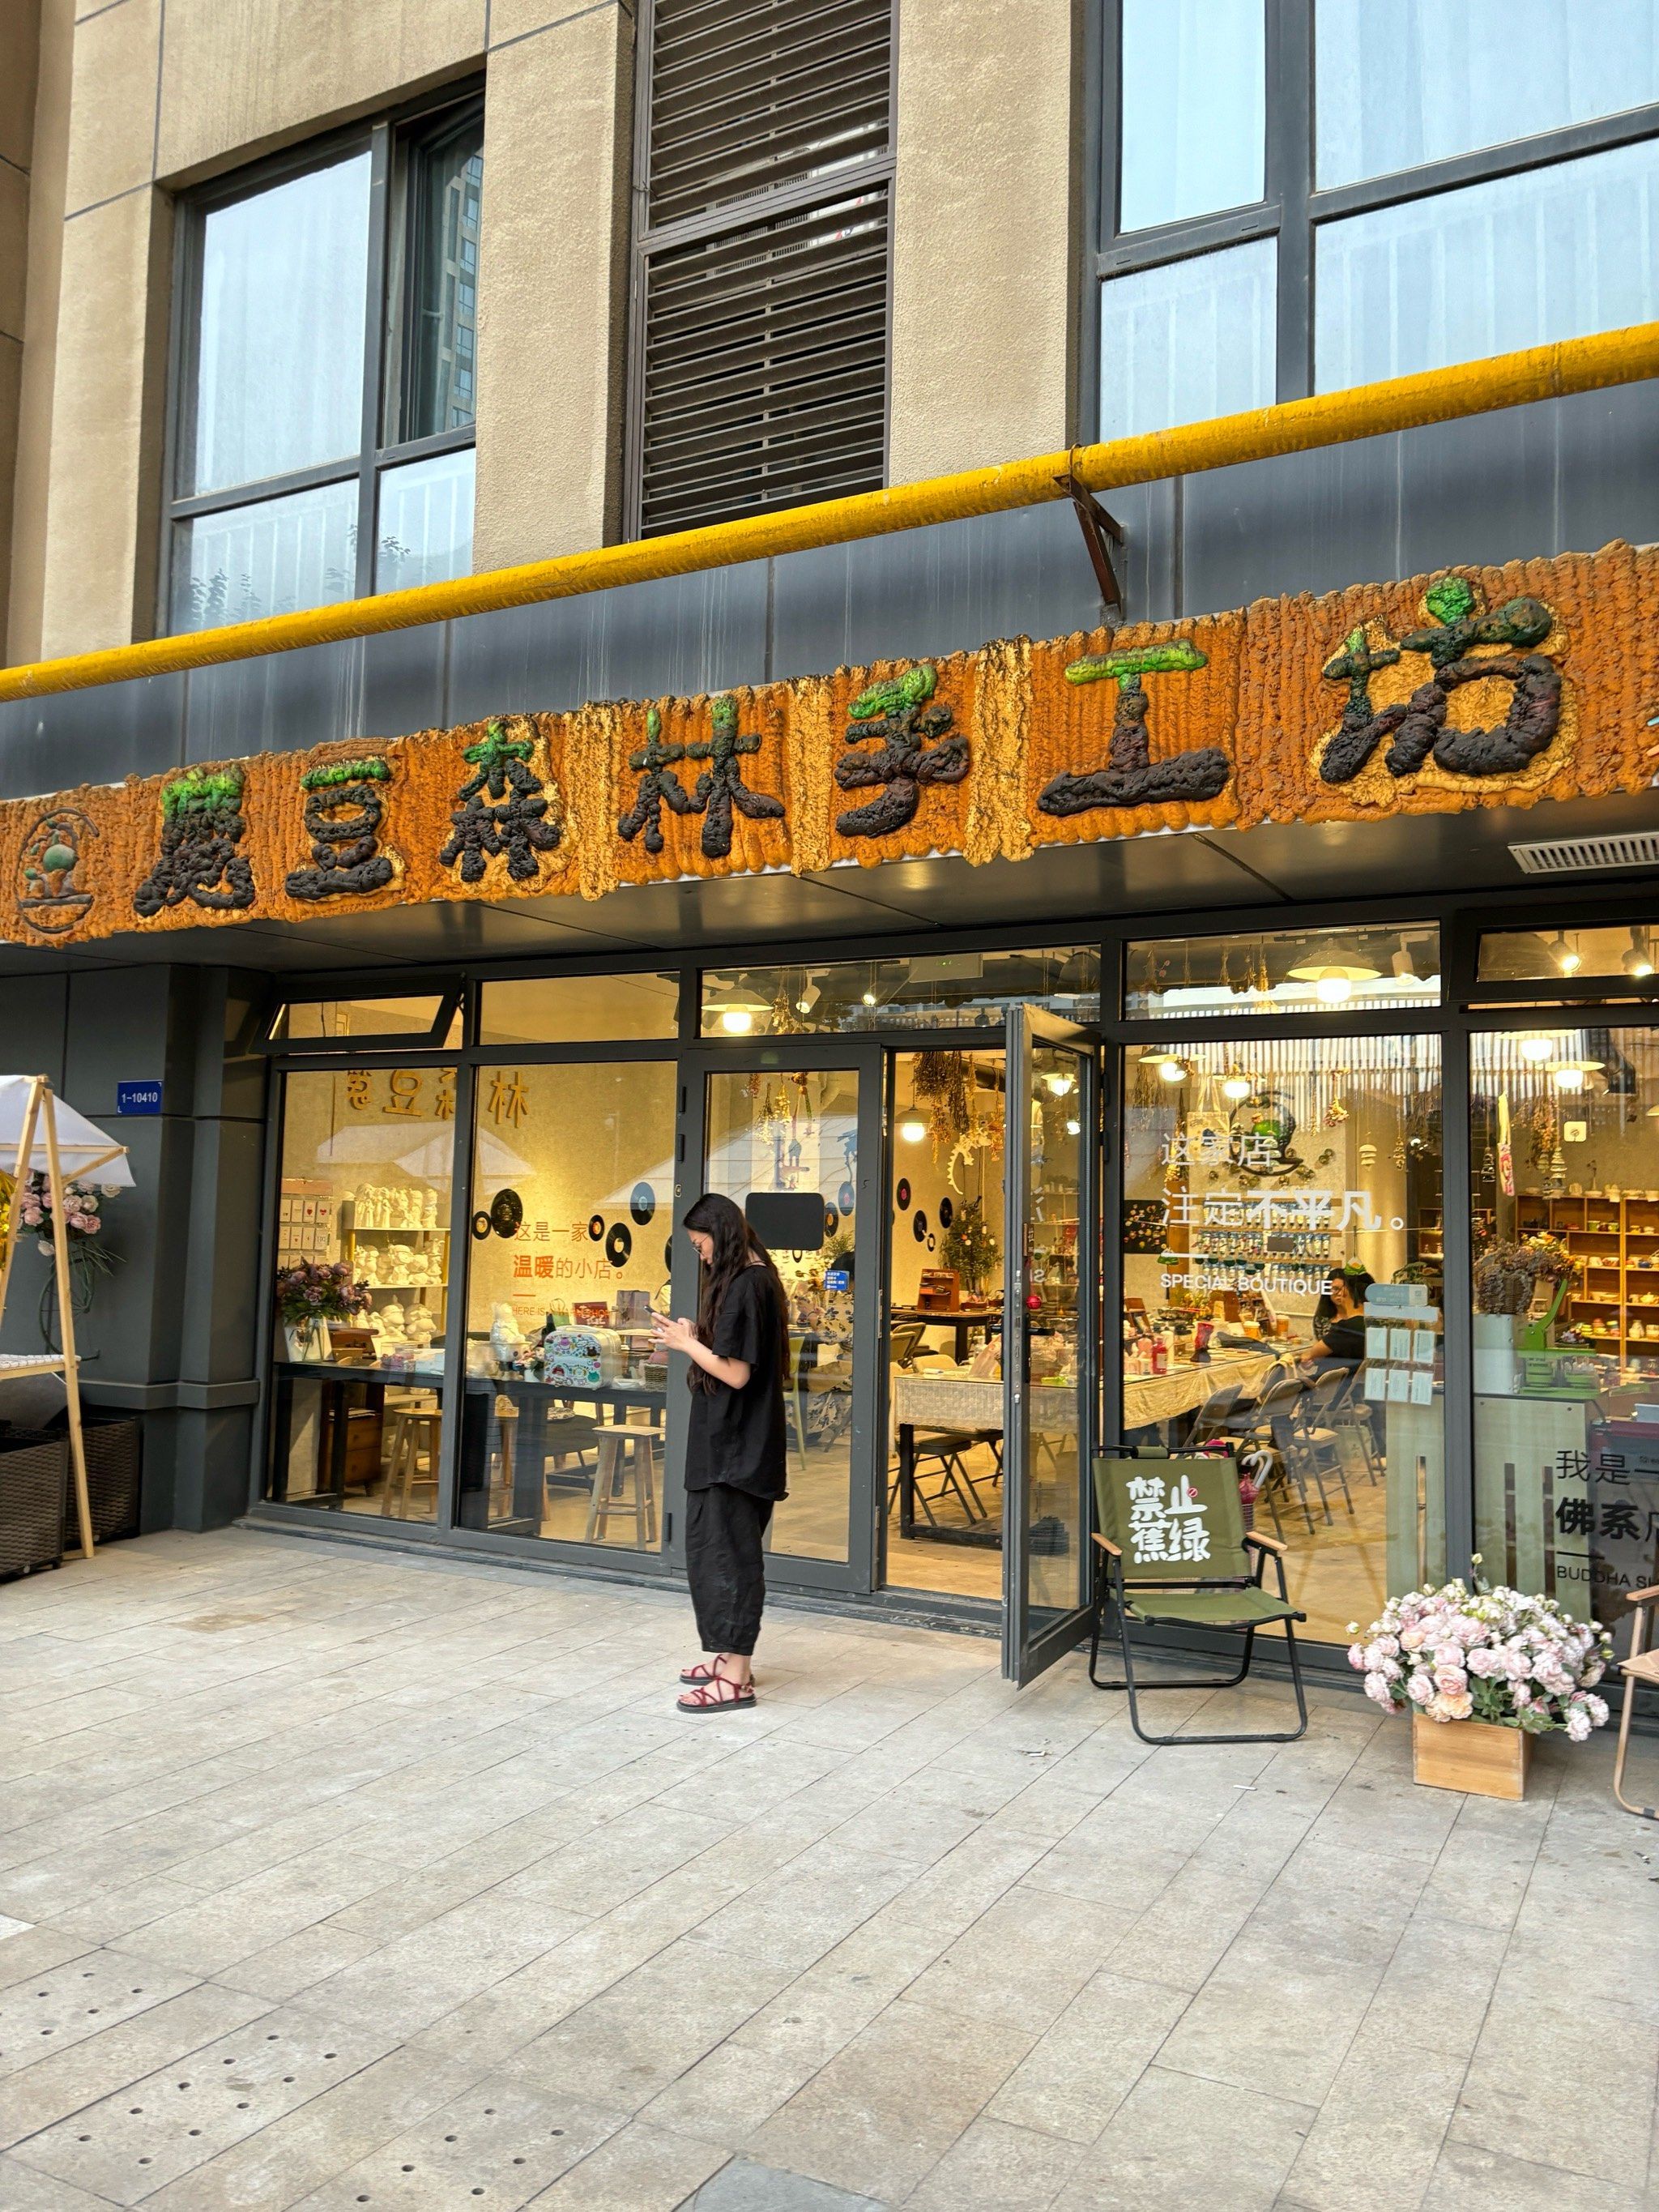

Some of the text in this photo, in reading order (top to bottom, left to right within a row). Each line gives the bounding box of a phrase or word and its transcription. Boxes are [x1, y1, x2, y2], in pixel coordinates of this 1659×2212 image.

[122, 1091, 158, 1103] 1-10410
[1162, 1132, 1277, 1168] 这家店
[514, 1221, 589, 1242] 这是一家
[1160, 1273, 1333, 1296] SPECIAL BOUTIQUE
[512, 1305, 535, 1316] HERE
[1126, 1475, 1208, 1521] 禁止
[1128, 1517, 1211, 1564] 蕉绿
[1557, 1565, 1631, 1586] BUDDHA
